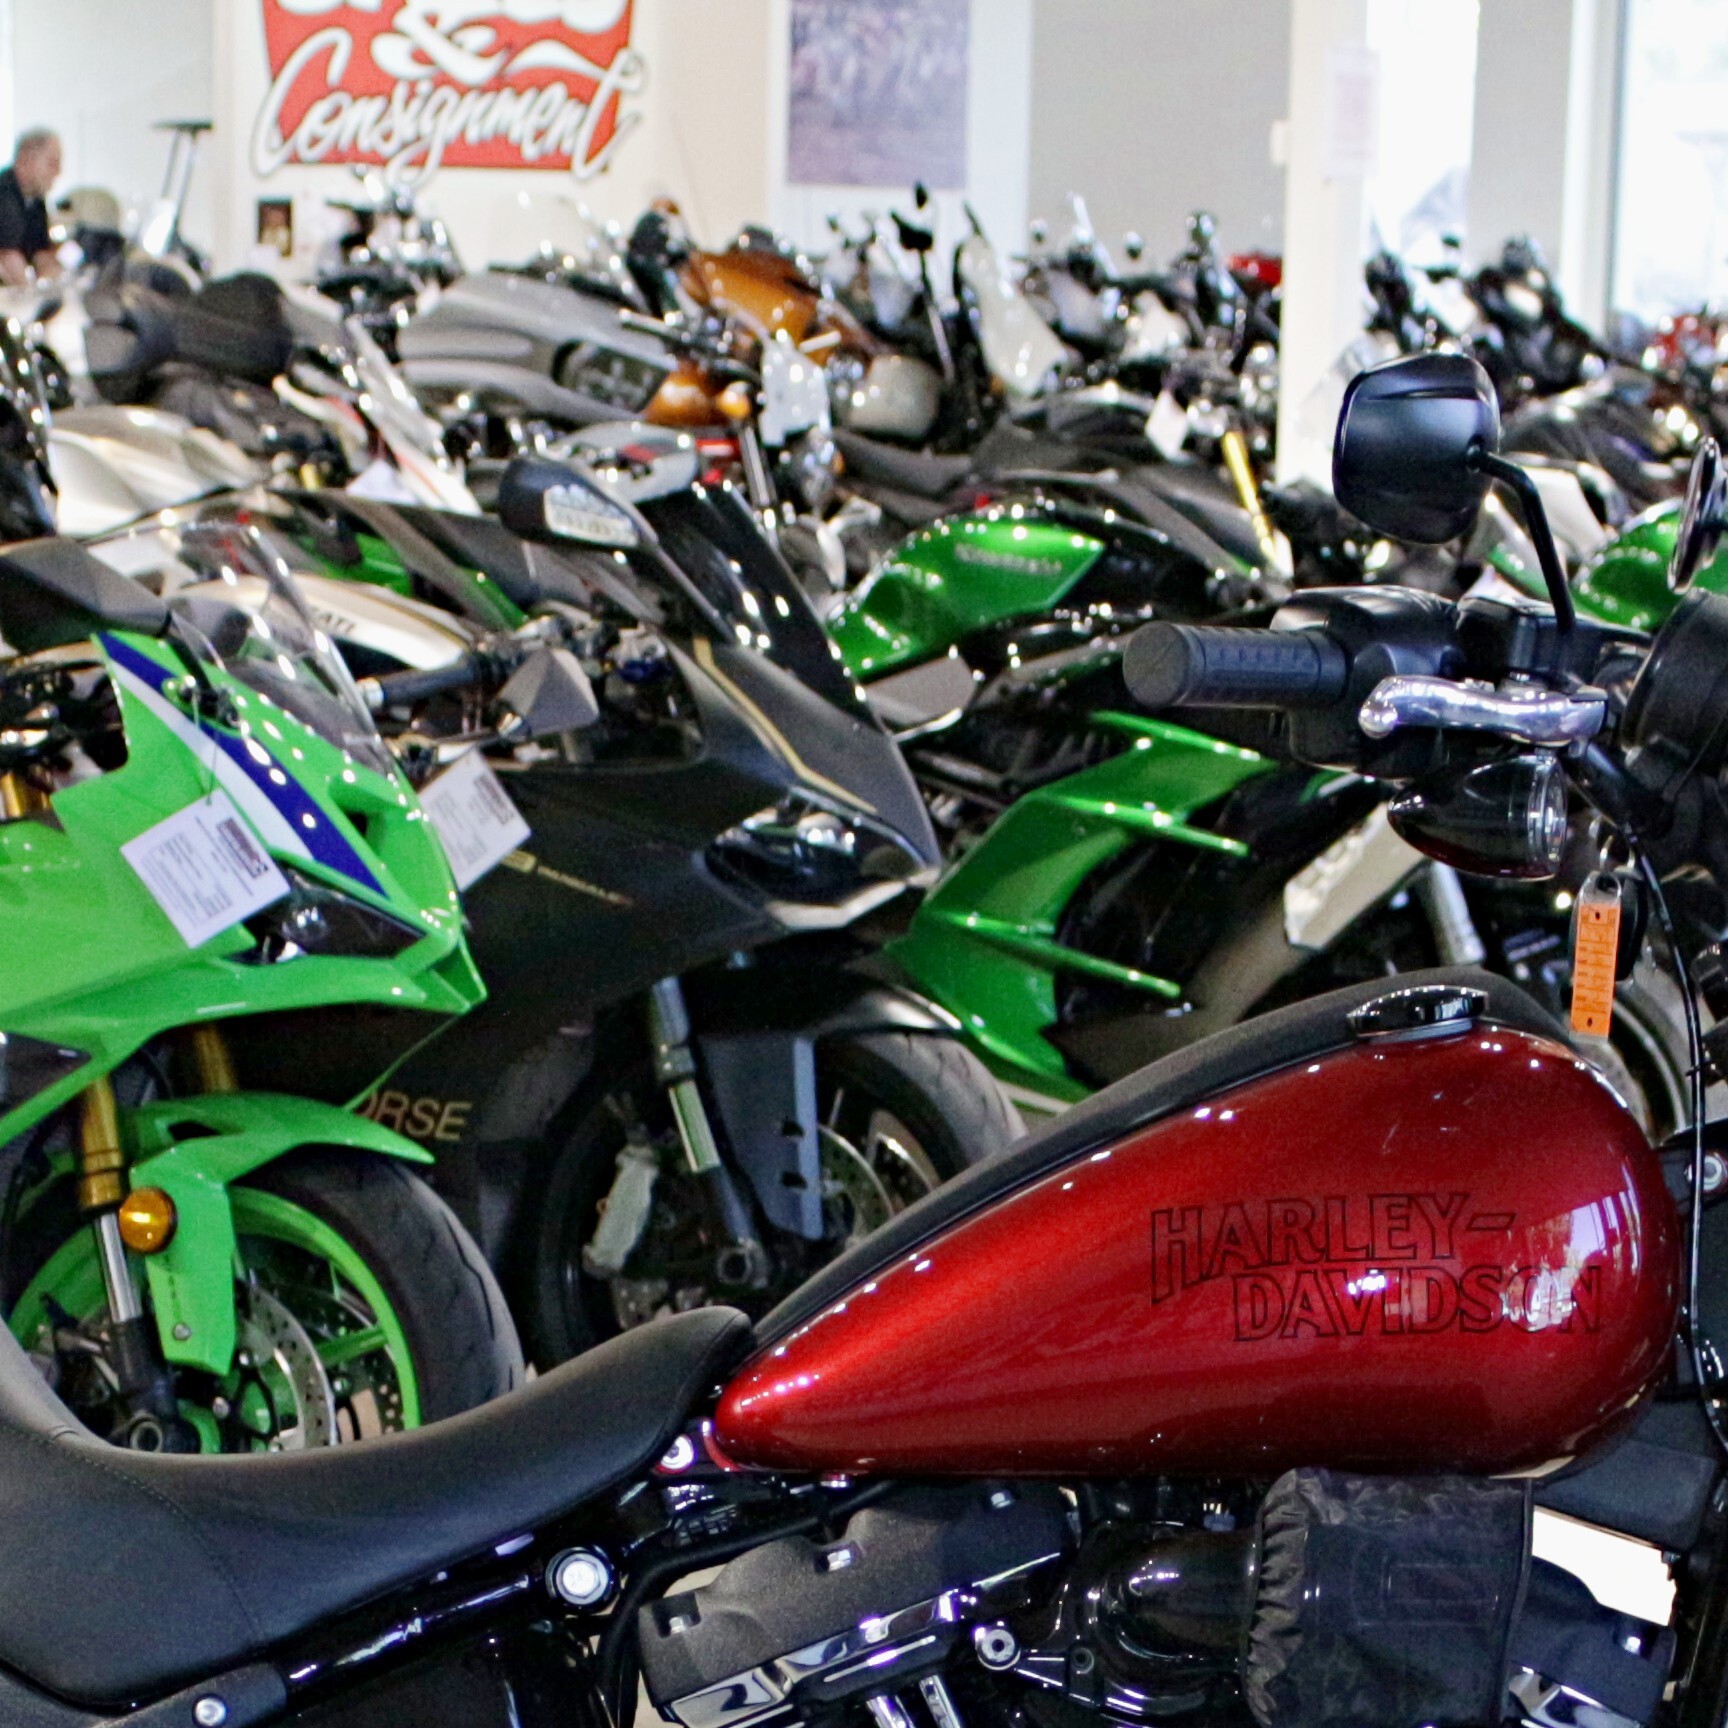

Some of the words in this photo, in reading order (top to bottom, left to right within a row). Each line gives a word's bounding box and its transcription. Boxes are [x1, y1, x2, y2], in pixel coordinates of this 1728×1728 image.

[252, 28, 646, 187] Consignment
[1151, 1193, 1515, 1305] HARLEY-
[1233, 1264, 1603, 1341] DAVIDSON
